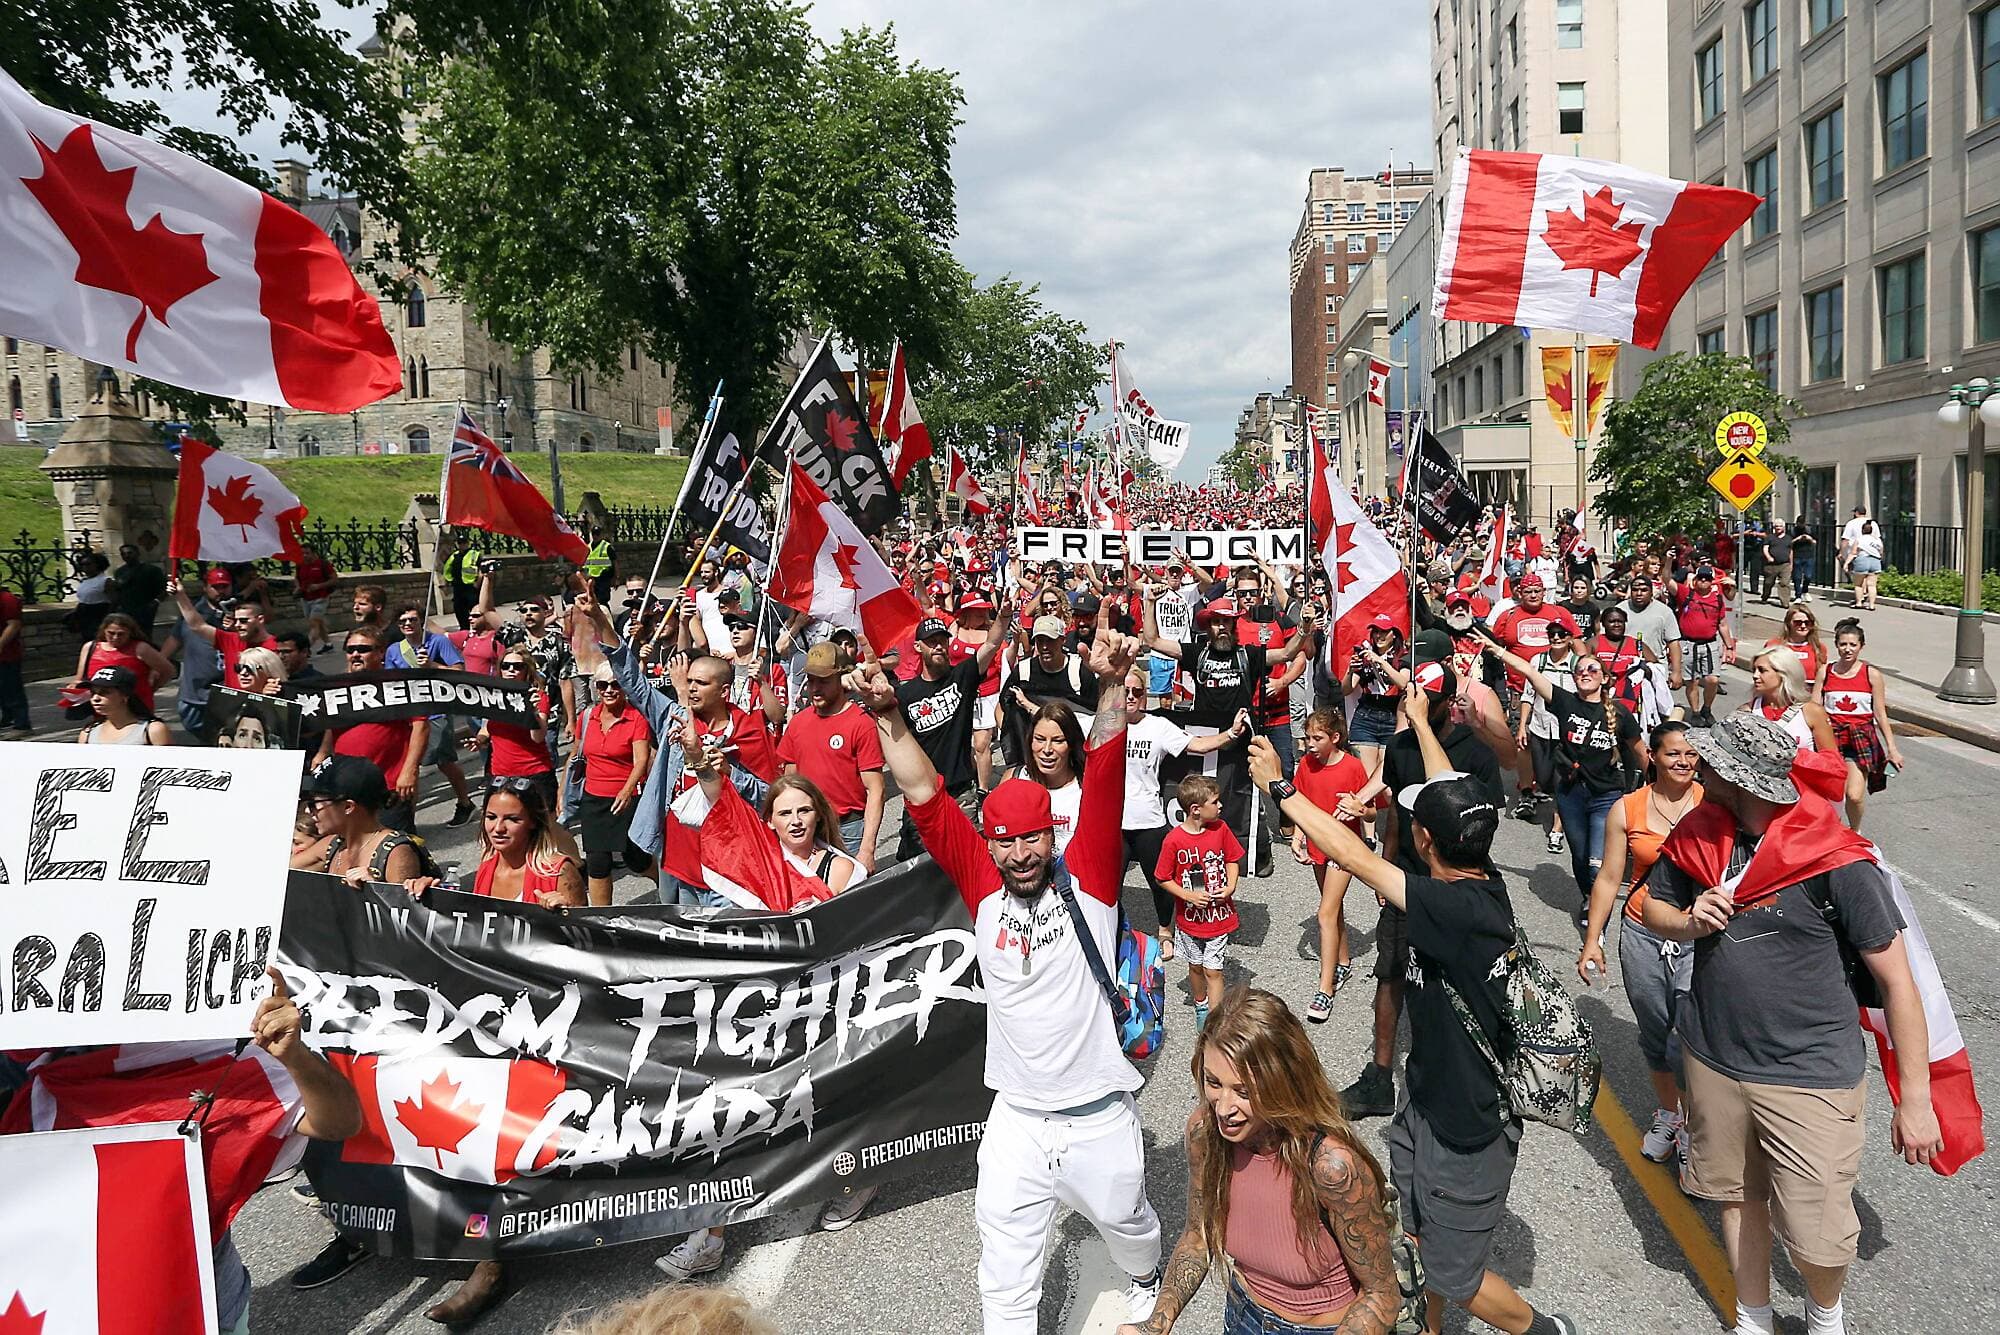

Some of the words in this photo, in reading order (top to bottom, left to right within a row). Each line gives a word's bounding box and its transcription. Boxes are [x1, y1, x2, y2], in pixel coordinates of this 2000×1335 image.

[1732, 425, 1749, 435] NEW
[1023, 531, 1301, 562] FREEDOM
[323, 679, 506, 716] FREEDOM
[1134, 740, 1153, 750] NOT
[0, 766, 233, 886] EE
[1177, 847, 1200, 865] OH
[1184, 904, 1234, 923] CANADA
[603, 928, 986, 1091] FIGHTER
[512, 1067, 823, 1175] CANADA
[341, 1203, 397, 1232] CANADA
[500, 1176, 755, 1238] @FREEDOMFIGHTERS_CANADA
